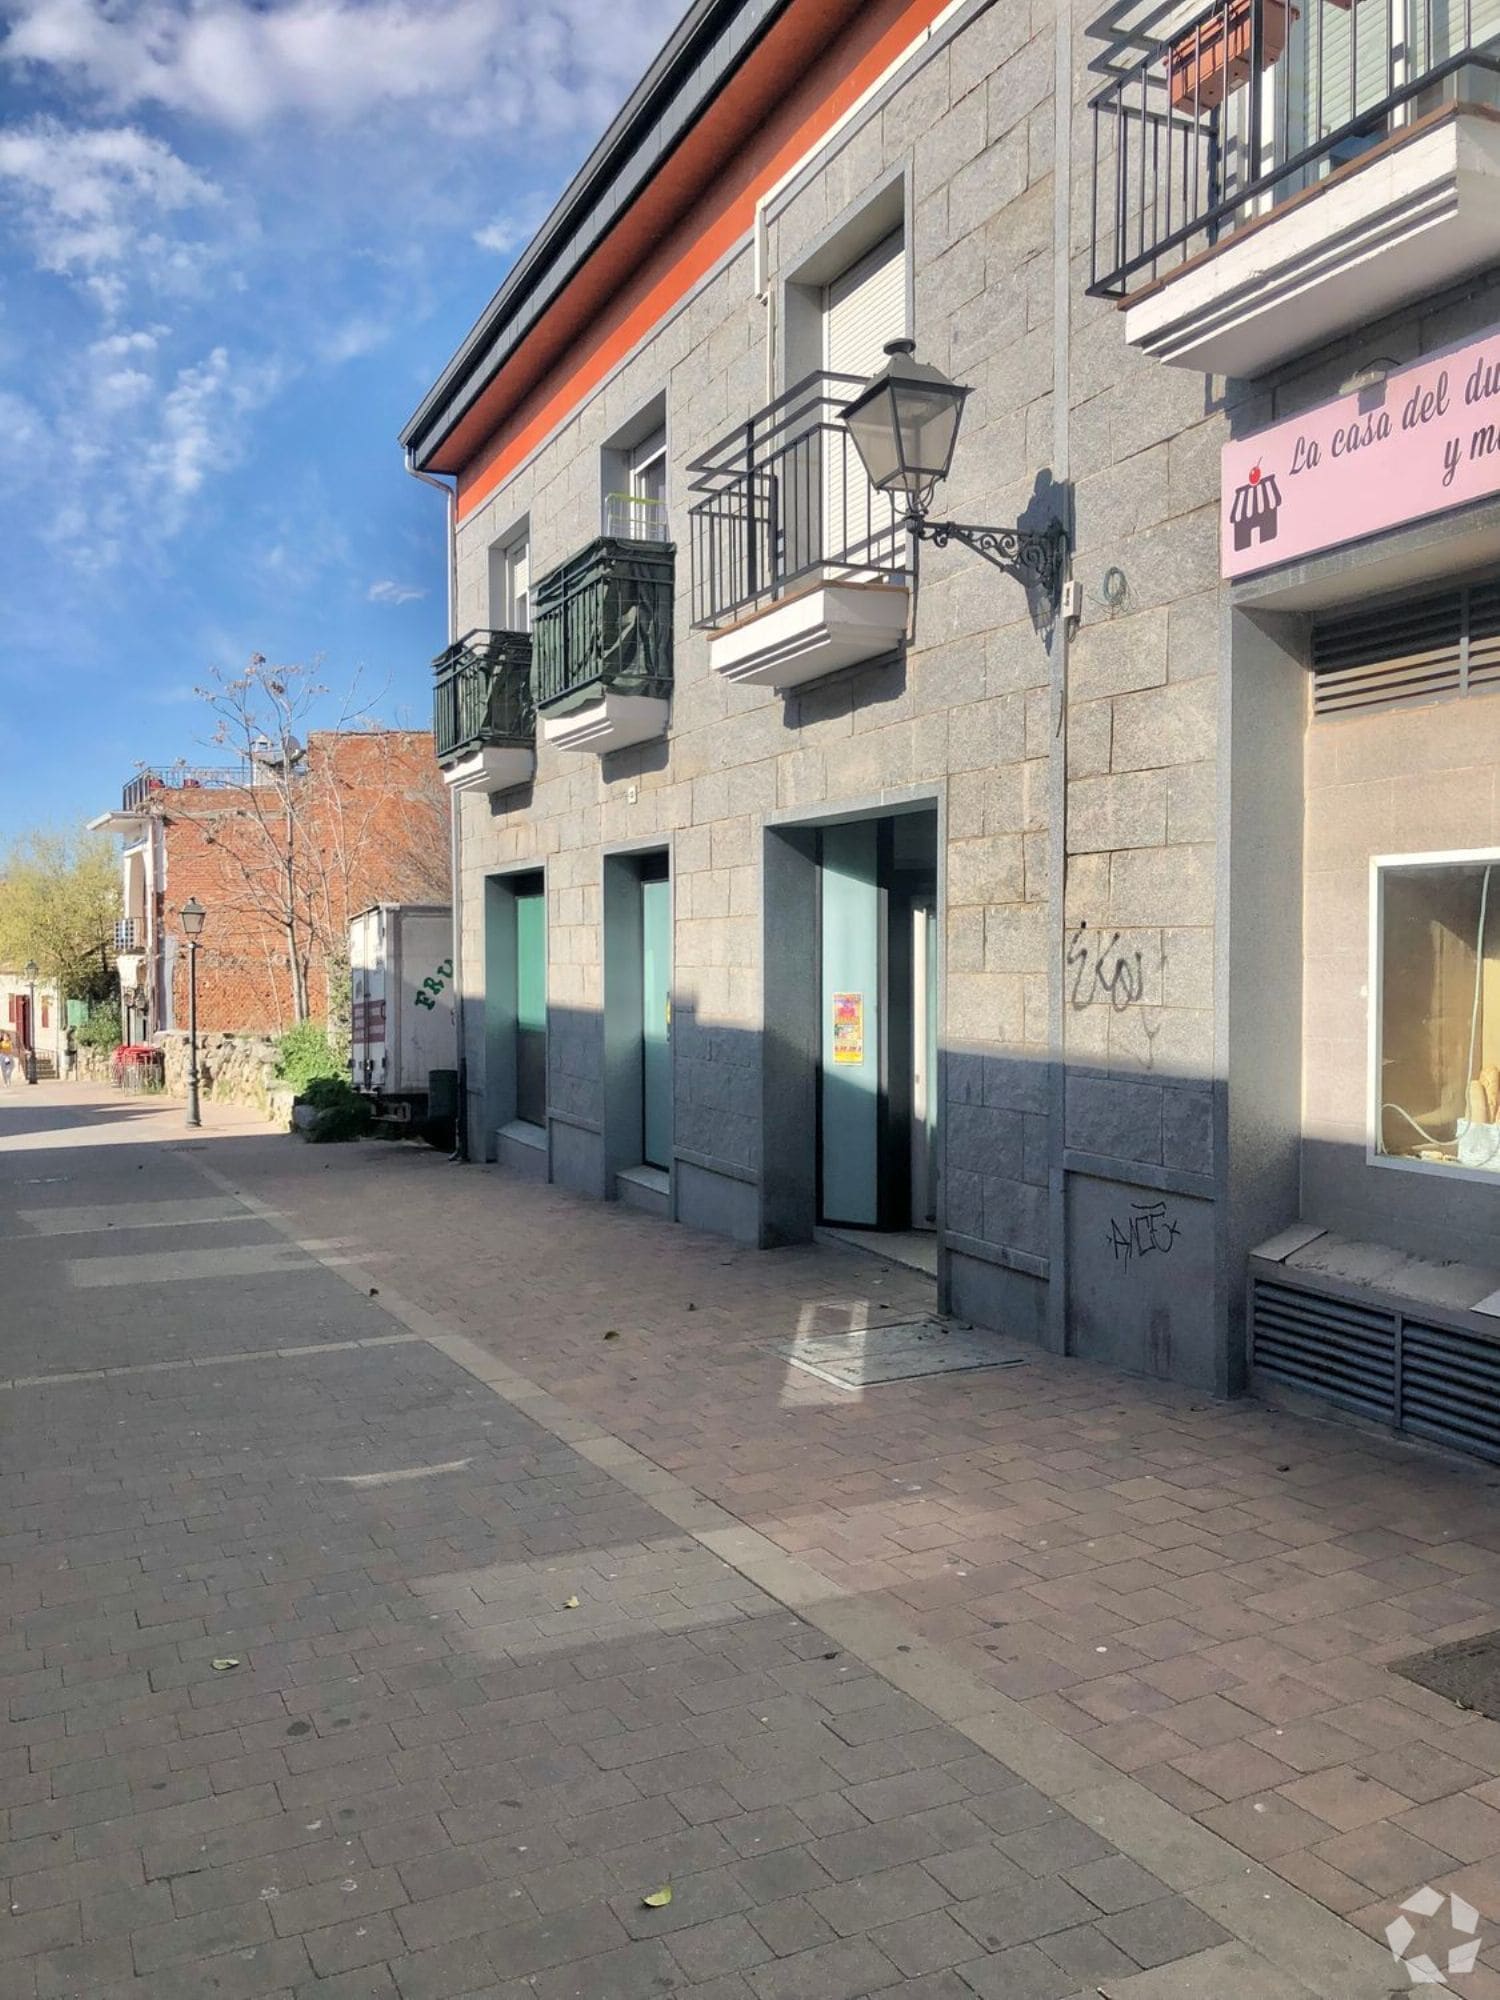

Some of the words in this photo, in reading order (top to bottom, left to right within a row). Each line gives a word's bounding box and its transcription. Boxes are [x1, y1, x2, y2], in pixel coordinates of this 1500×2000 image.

[1289, 436, 1322, 475] La
[1331, 412, 1393, 457] casa
[1402, 371, 1450, 430] del
[1442, 438, 1462, 487] y
